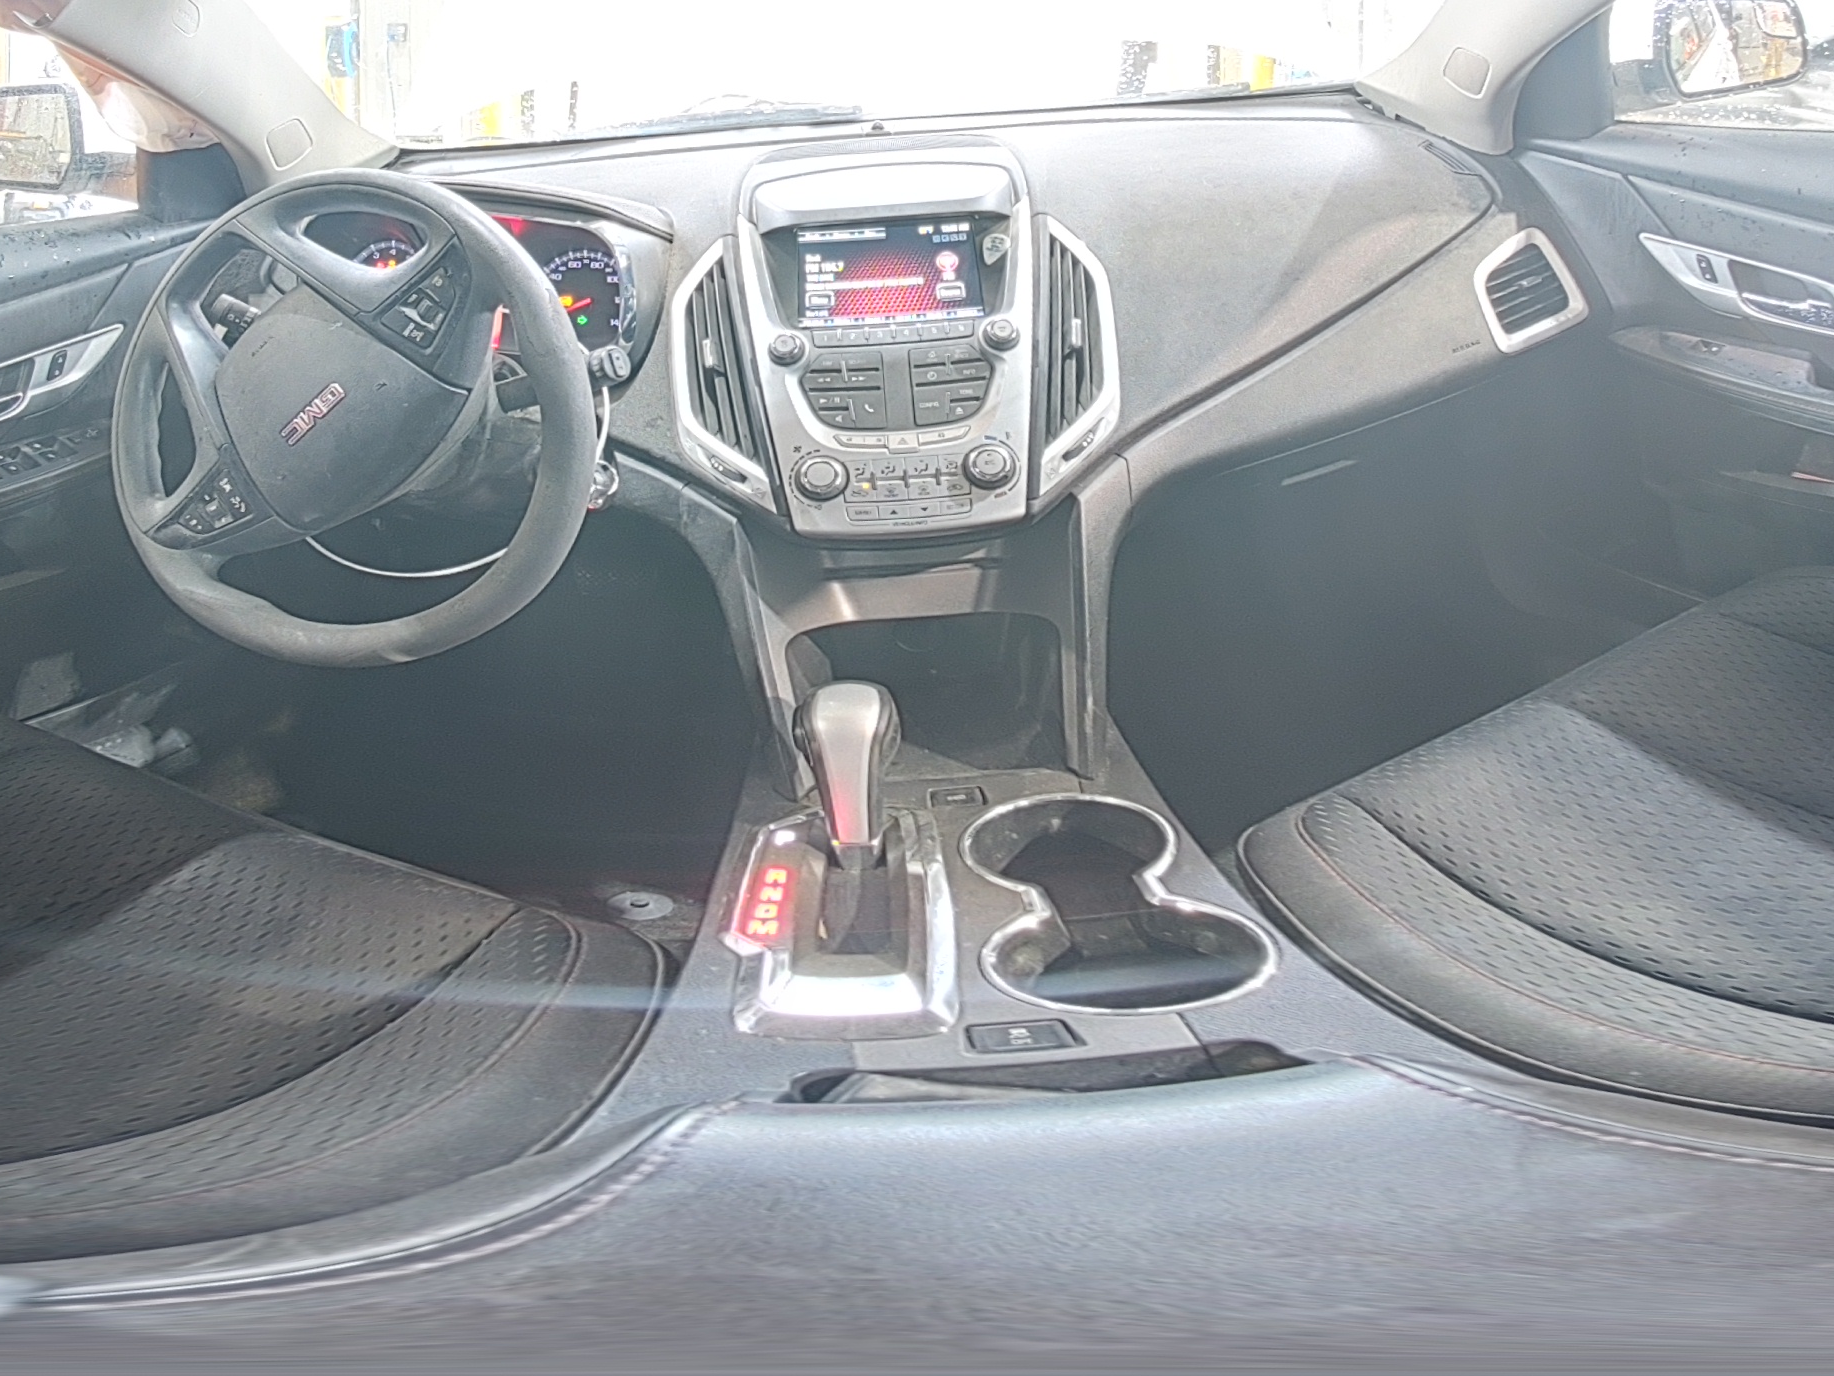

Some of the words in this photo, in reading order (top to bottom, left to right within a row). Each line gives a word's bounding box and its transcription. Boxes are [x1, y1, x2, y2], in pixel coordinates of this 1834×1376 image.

[372, 252, 381, 260] 3
[568, 260, 582, 269] 60
[590, 261, 604, 270] 80
[279, 382, 346, 447] GMC
[765, 868, 787, 884] R
[760, 886, 784, 902] N
[747, 920, 779, 935] M
